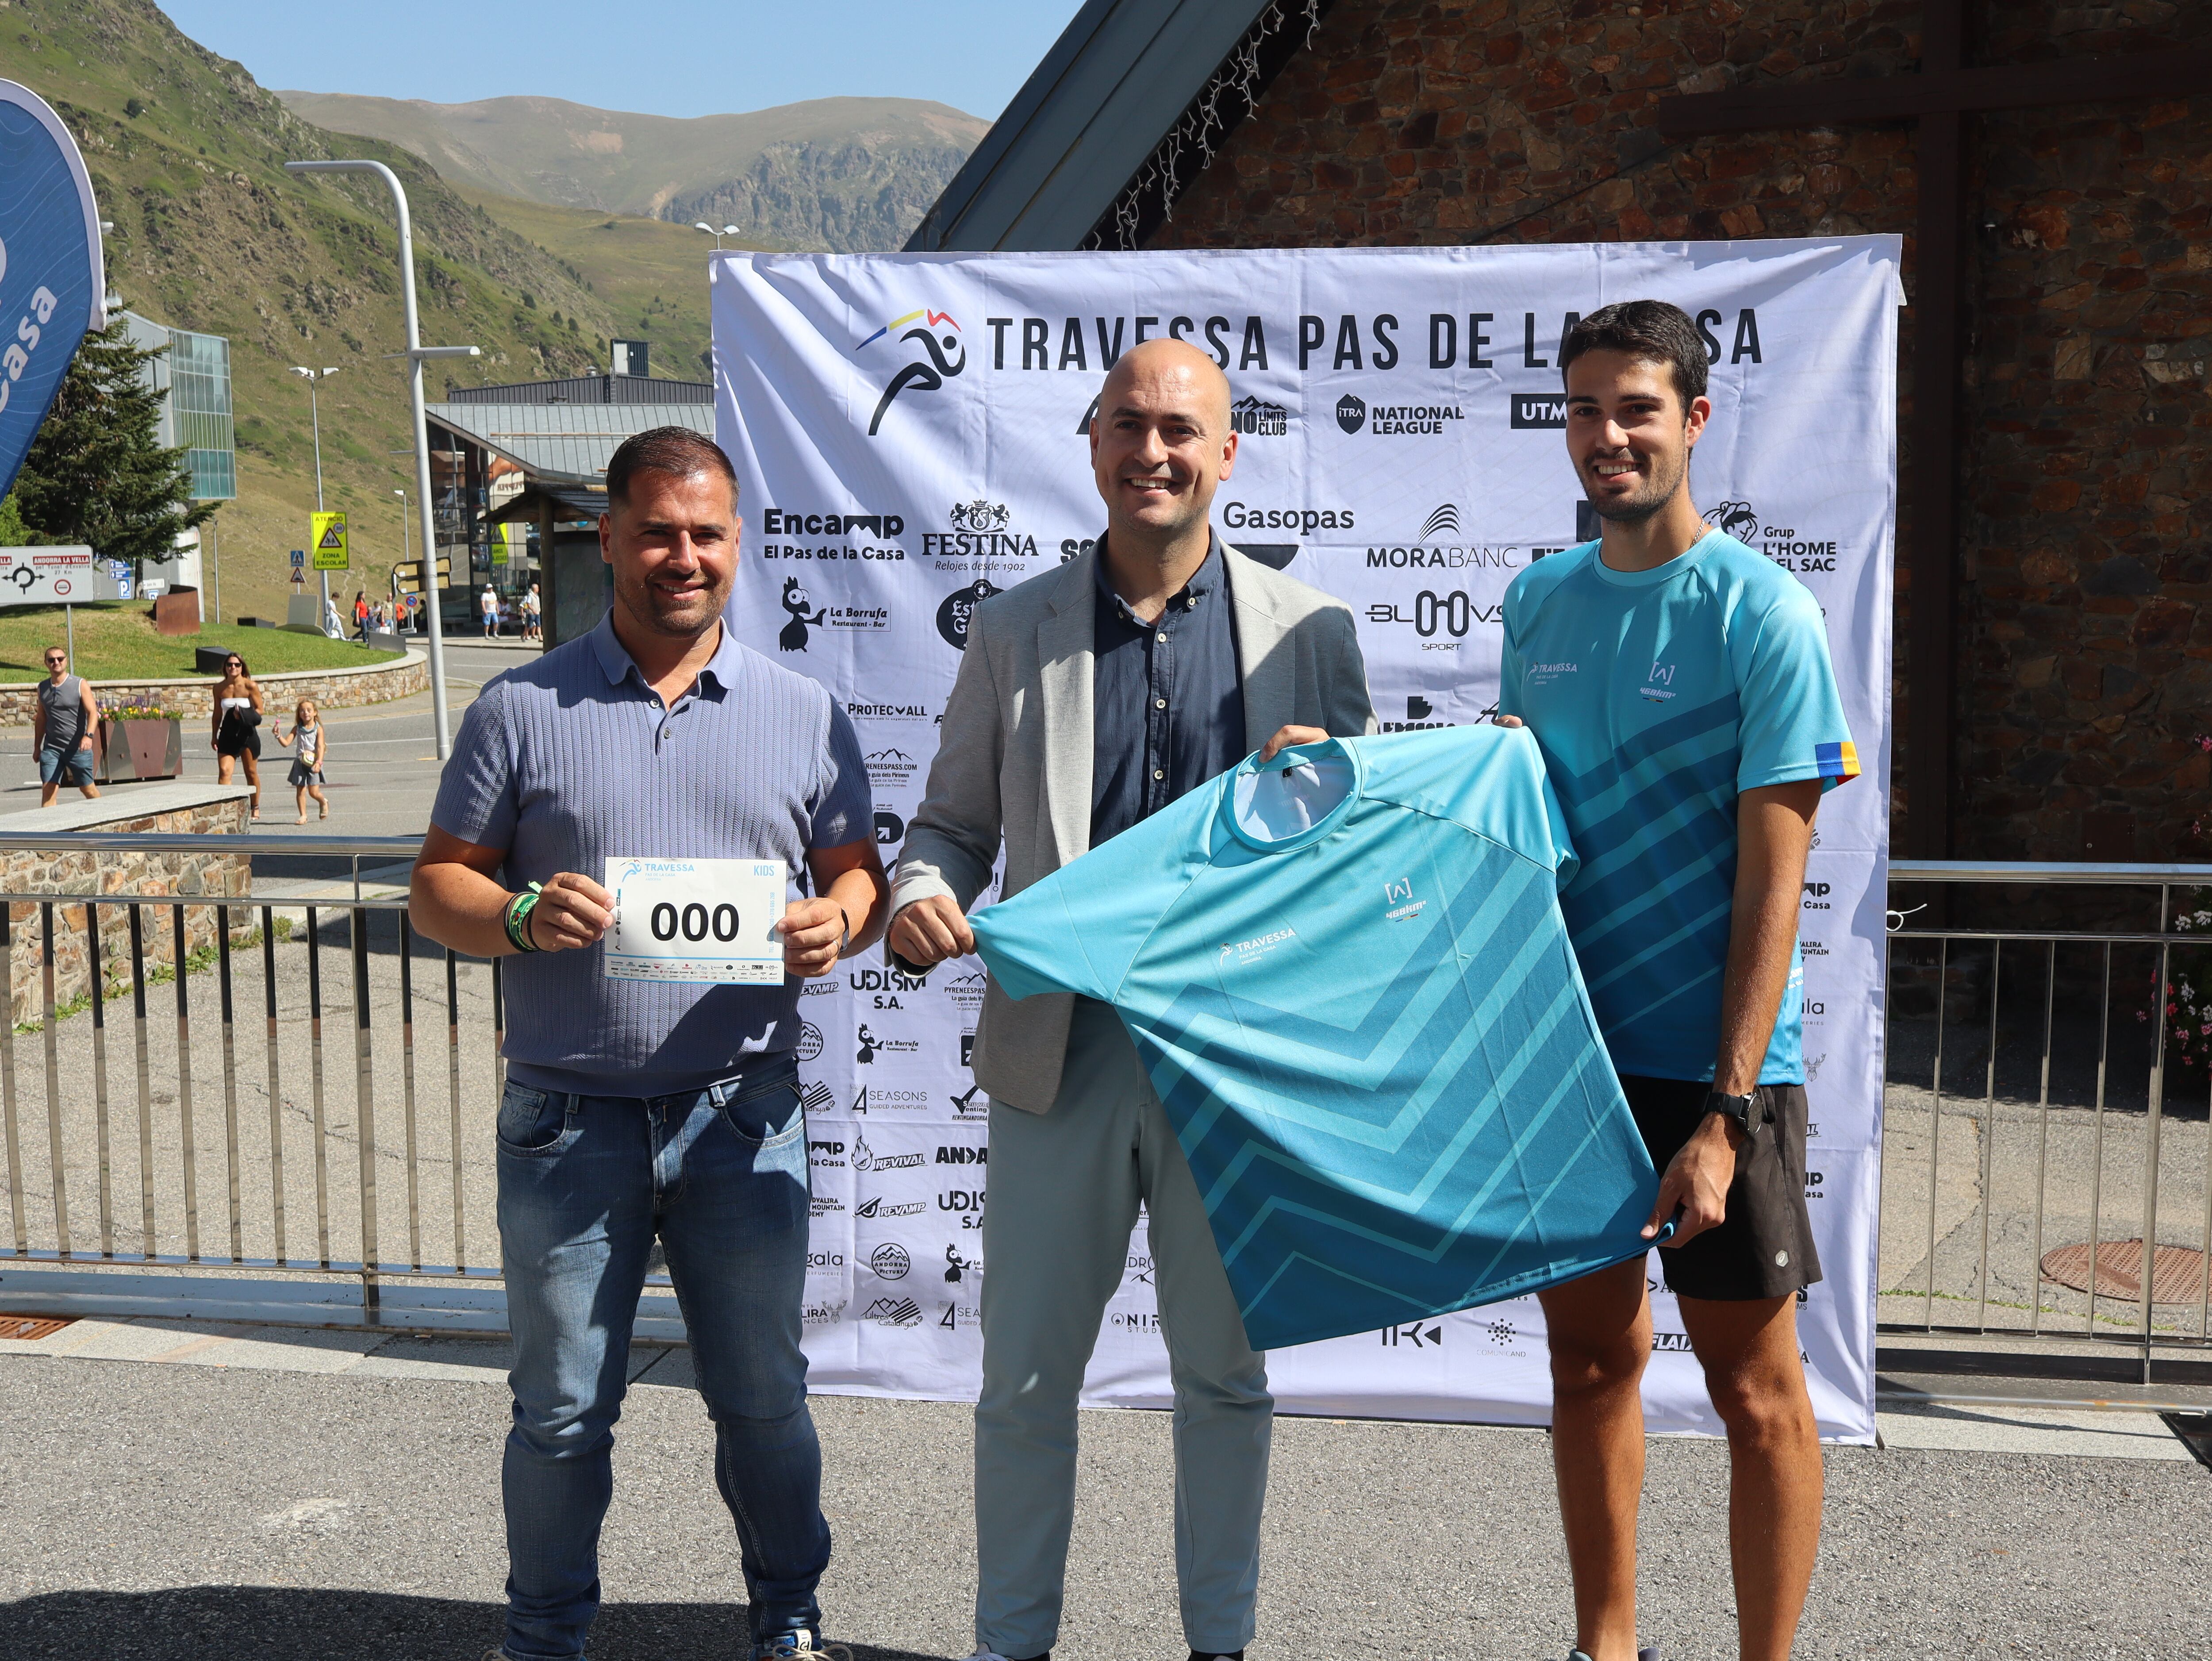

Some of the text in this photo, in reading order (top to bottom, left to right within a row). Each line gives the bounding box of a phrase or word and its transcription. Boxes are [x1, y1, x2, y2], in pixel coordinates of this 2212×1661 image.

[1300, 313, 1398, 370] PAS
[1430, 312, 1494, 369] DE
[1525, 311, 1581, 368] LA
[1695, 308, 1763, 365] SA
[1258, 409, 1287, 422] LÍMITS
[1373, 406, 1465, 420] NATIONAL
[1521, 402, 1567, 421] UTM
[1258, 422, 1287, 436] CLUB
[1373, 421, 1443, 434] LEAGUE
[764, 508, 905, 539] Encamp
[1223, 501, 1355, 536] Gasopas
[1763, 526, 1795, 539] Grup
[922, 532, 1040, 557] FESTINA
[1763, 542, 1837, 556] L'HOME
[764, 545, 905, 561] El Pas de la Casa
[1366, 547, 1518, 568] MORABANC
[935, 560, 1025, 572] Relojes desde 1902
[1770, 558, 1836, 572] EL SAC
[830, 607, 887, 620] La Borrufa
[1539, 663, 1578, 673] TRAVESSA
[645, 863, 695, 872] TRAVESSA
[754, 865, 775, 876] KIDS
[1803, 900, 1831, 909] Casa
[650, 902, 740, 942] 000
[1235, 928, 1297, 953] TRAVESSA
[801, 982, 839, 996] EVAMP
[874, 996, 904, 1010] S.A.
[869, 1091, 928, 1101] SEASONS
[810, 1157, 845, 1167] la Casa
[874, 1153, 926, 1171] REVIVAL
[938, 1190, 986, 1211] UDI
[879, 1202, 927, 1217] REVAMP
[962, 1215, 983, 1229] S.A
[806, 1250, 843, 1269] gala
[865, 1311, 889, 1320] Ultres
[1652, 1334, 1692, 1351] FLAI
